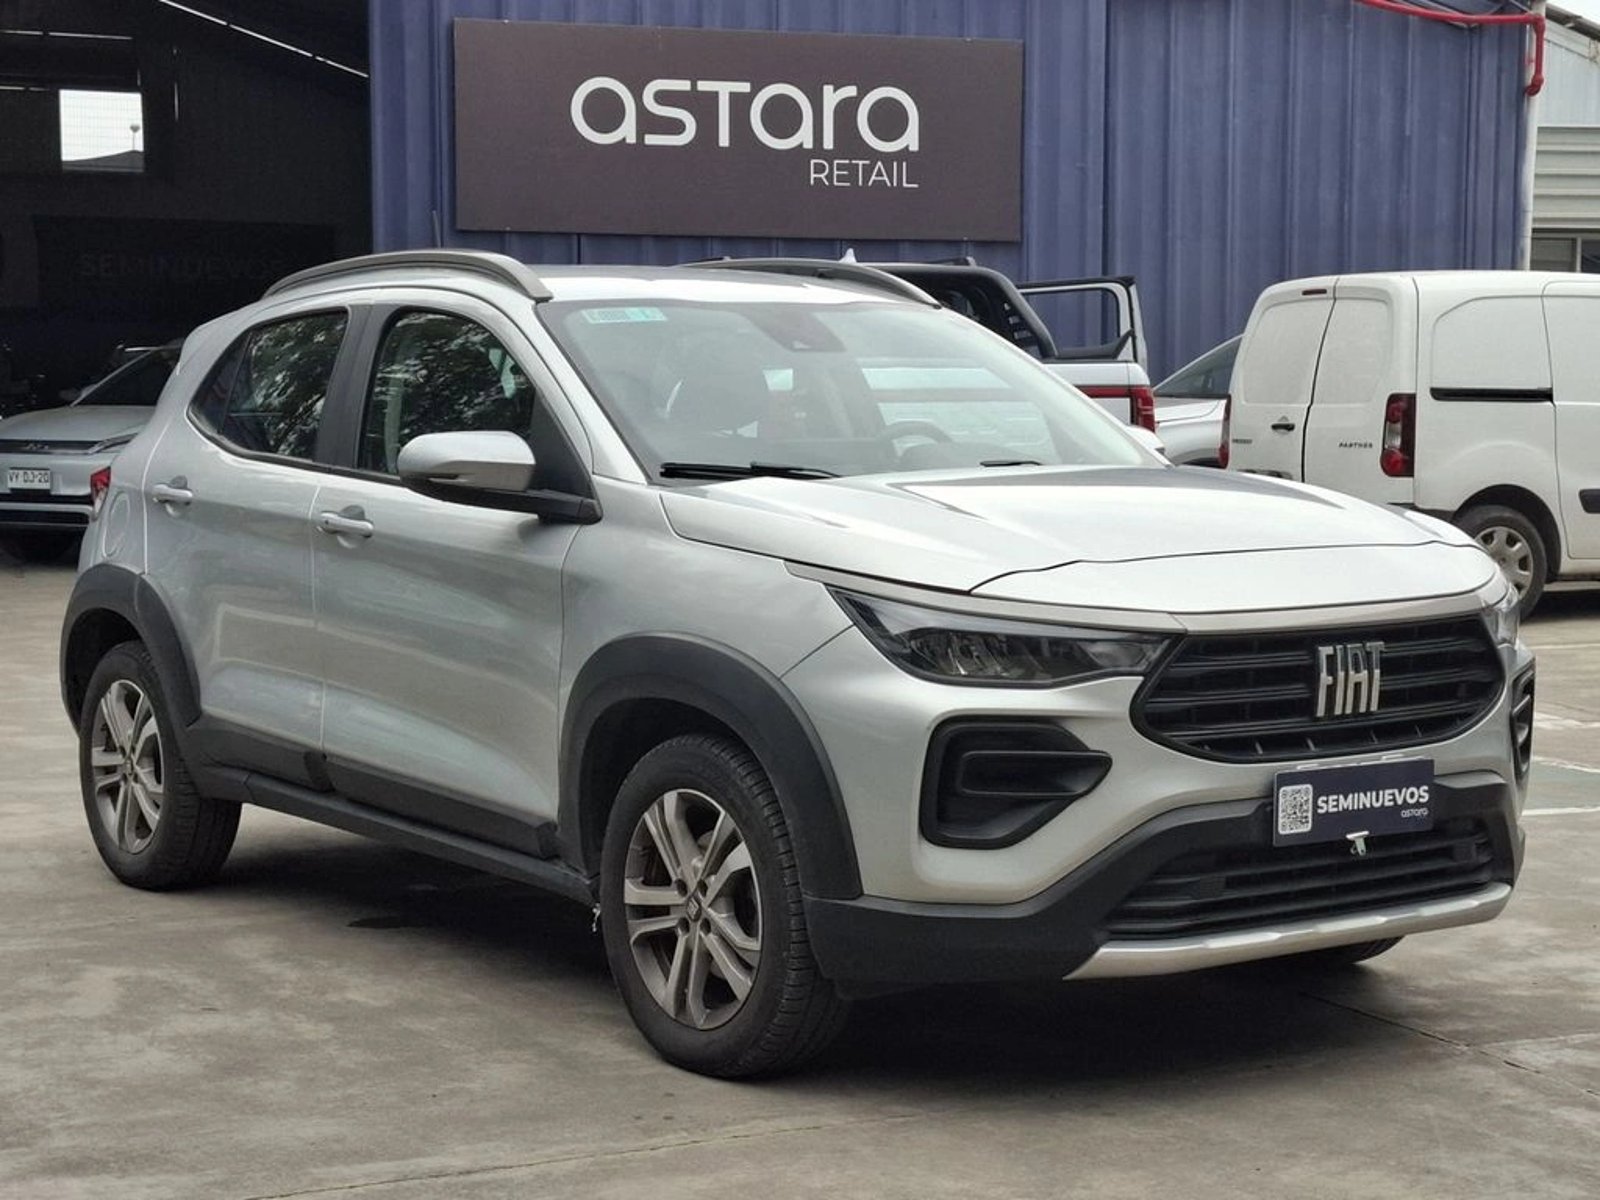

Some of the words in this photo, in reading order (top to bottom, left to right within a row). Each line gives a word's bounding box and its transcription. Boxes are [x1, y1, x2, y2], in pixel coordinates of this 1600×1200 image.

[809, 158, 919, 188] RETAIL
[1317, 642, 1385, 717] FIAT
[1317, 785, 1429, 814] SEMINUEVOS
